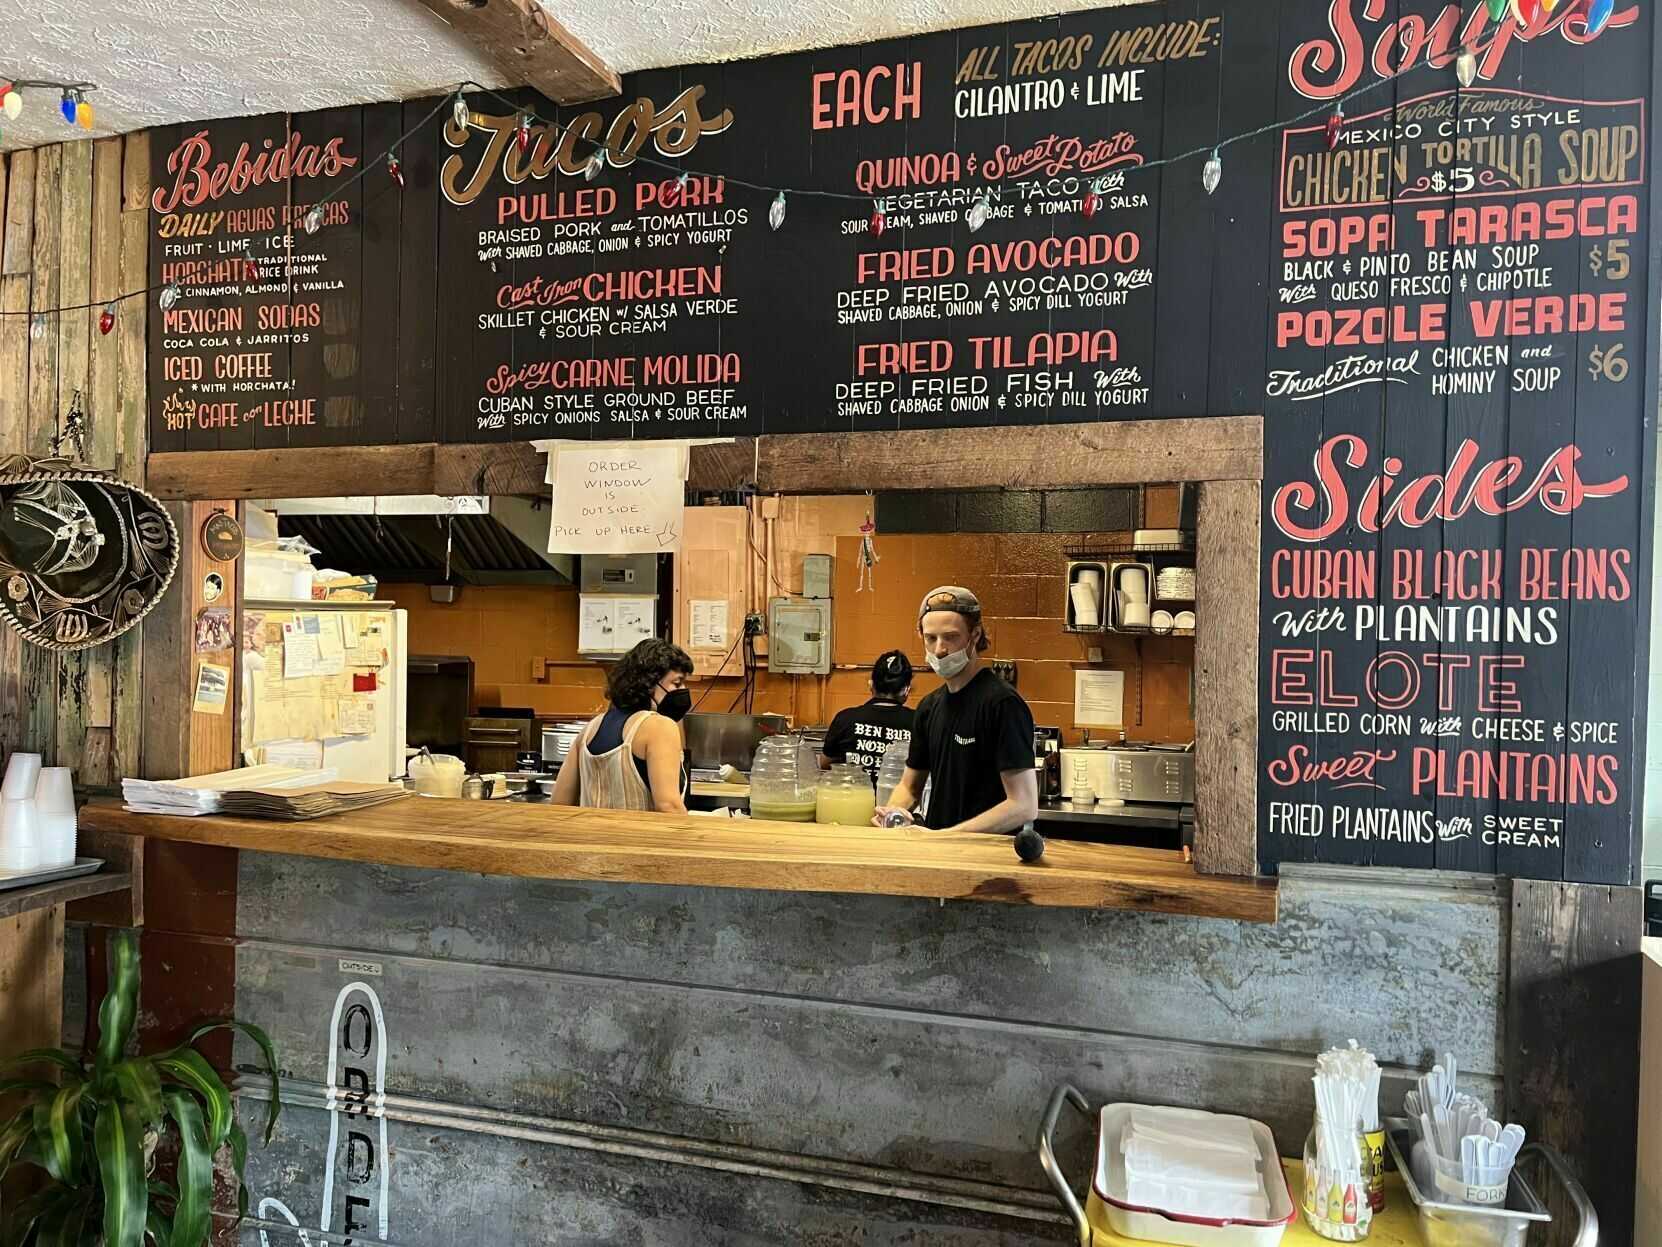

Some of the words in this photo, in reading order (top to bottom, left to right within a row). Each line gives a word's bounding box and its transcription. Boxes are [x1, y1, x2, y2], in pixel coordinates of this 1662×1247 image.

[955, 46, 1001, 85] ALL
[1011, 34, 1093, 76] TACOS
[1098, 17, 1221, 70] INCLUDE:
[1289, 0, 1640, 100] Soups
[812, 62, 922, 130] EACH
[954, 78, 1064, 118] CILANTRO
[1087, 69, 1146, 106] LIME
[1384, 95, 1456, 122] World
[1457, 93, 1545, 113] Famous
[1328, 122, 1422, 145] MEXICO
[1438, 116, 1496, 137] CITY
[1510, 109, 1581, 129] STYLE
[440, 84, 734, 206] Tacos
[152, 130, 358, 213] Bebidas
[856, 152, 961, 194] QUINOA
[983, 132, 1059, 180] Sweet
[1047, 131, 1144, 176] Potato
[1287, 144, 1407, 207] CHICKEN
[1421, 132, 1542, 189] TORTILLA
[1558, 125, 1638, 186] SOUP
[1016, 176, 1080, 200] TACO
[1431, 166, 1475, 193] $5
[498, 187, 616, 225] PULLED
[635, 176, 724, 211] PORK
[841, 220, 868, 235] SOUR
[919, 210, 957, 225] SHAVED
[1110, 194, 1149, 209] SALSA
[158, 210, 224, 238] DAILY
[227, 207, 276, 233] AGUAS
[478, 228, 541, 246] BRAISED
[555, 222, 601, 239] PORK
[611, 220, 635, 233] and
[638, 208, 748, 233] TOMATILLOS
[1283, 214, 1395, 259] SOPA
[1417, 195, 1637, 248] TARASCA
[165, 243, 204, 256] FRUIT
[266, 235, 295, 249] ICE
[258, 254, 328, 264] TRADITIONAL
[478, 248, 502, 262] With
[505, 245, 542, 260] SHAVED
[547, 240, 594, 256] CABBAGE,
[598, 237, 629, 252] ONION
[648, 233, 679, 247] SPICY
[686, 229, 732, 245] YOGURT
[857, 247, 954, 284] FRIED
[967, 231, 1140, 275] AVOCADO
[1589, 239, 1631, 280] $5
[259, 266, 281, 278] RICE
[285, 265, 319, 276] DRINK
[1284, 260, 1334, 282] BLACK
[1360, 253, 1411, 277] PINTO
[1427, 248, 1477, 272] BEAN
[1492, 244, 1539, 268] SOUP
[186, 286, 242, 297] CINNAMON,
[245, 284, 288, 294] ALMOND
[303, 280, 344, 290] VANILLA
[496, 276, 543, 309] Cast
[537, 277, 582, 306] Iron
[583, 265, 722, 301] CHICKEN
[837, 289, 889, 309] DEEP
[903, 282, 969, 304] FRIED
[984, 272, 1109, 298] AVOCADO
[1114, 268, 1153, 288] With
[1279, 285, 1317, 304] With
[1331, 278, 1378, 301] QUESO
[1390, 274, 1451, 298] FRESCO
[1476, 267, 1552, 292] CHIPOTLE
[164, 307, 242, 334] MEXICAN
[258, 303, 320, 330] SODAS
[478, 311, 535, 329] SKILLET
[540, 307, 610, 325] CHICKEN
[634, 303, 677, 320] SALSA
[686, 299, 738, 316] VERDE
[838, 309, 882, 325] SHAVED
[889, 304, 941, 321] CABBAGE,
[945, 301, 983, 317] ONION
[1009, 296, 1041, 312] SPICY
[1046, 294, 1070, 309] DILL
[1078, 291, 1129, 307] YOGURT
[1276, 303, 1447, 348] POZOLE
[1469, 293, 1628, 338] VERDE
[163, 338, 193, 349] COCA
[200, 337, 229, 347] COLA
[248, 333, 309, 345] JARRITOS
[556, 324, 601, 338] SOUR
[609, 320, 667, 335] CREAM
[164, 356, 203, 381] ICED
[215, 353, 273, 379] COFFEE
[858, 340, 952, 376] FRIED
[968, 329, 1117, 370] TILAPIA
[1432, 345, 1509, 369] CHICKEN
[1520, 344, 1552, 359] and
[1588, 343, 1628, 383] $6
[201, 382, 227, 394] WITH
[486, 361, 551, 395] Spicy
[551, 357, 636, 388] CARNE
[643, 353, 741, 385] MOLIDA
[836, 381, 895, 399] DEEP
[912, 375, 988, 397] FRIED
[1007, 371, 1073, 393] FISH
[1094, 366, 1141, 389] With
[1265, 350, 1421, 401] Traditional
[1432, 371, 1497, 396] HOMINY
[1513, 368, 1561, 393] SOUP
[167, 412, 193, 431] HOT
[199, 403, 238, 429] CAFE
[243, 405, 262, 422] con
[263, 399, 316, 427] LECHE
[477, 414, 506, 429] With
[513, 413, 549, 425] SPICY
[555, 411, 600, 424] ONIONS
[610, 409, 649, 422] SALSA
[667, 407, 700, 421] SOUR
[705, 406, 747, 420] CREAM
[479, 396, 534, 413] CUBAN
[543, 394, 595, 410] STYLE
[604, 392, 675, 407] GROUND
[686, 389, 736, 405] BEEF
[837, 400, 882, 416] SHAVED
[890, 398, 943, 414] CABBAGE
[951, 396, 989, 411] ONION
[1015, 392, 1054, 408] SPICY
[1062, 390, 1087, 406] DILL
[1094, 388, 1149, 405] YOGURT
[584, 478, 652, 489] WINDOW
[588, 461, 641, 473] ORDER
[605, 491, 616, 500] IS
[1272, 434, 1629, 543] Sides
[582, 504, 640, 516] OUTSIDE
[555, 526, 581, 537] PICK
[595, 526, 611, 536] UP
[620, 524, 651, 535] HERE
[1272, 549, 1375, 599] CUBAN
[1392, 549, 1501, 600] BLACK
[1520, 548, 1631, 601] BEANS
[1273, 607, 1347, 638] With
[1355, 605, 1558, 645] PLANTAINS
[1272, 649, 1525, 713] ELOTE
[854, 722, 883, 740] BEN
[1272, 711, 1350, 735] GRILLED
[1360, 713, 1412, 736] CORN
[1472, 717, 1545, 742] CHEESE
[1570, 720, 1619, 744] SPICE
[1268, 744, 1397, 792] Sweet
[1412, 747, 1618, 805] PLANTAINS
[1269, 802, 1324, 838] FRIED
[1332, 805, 1434, 844] PLANTAINS
[1435, 815, 1473, 841] With
[1481, 830, 1561, 848] CREAM
[1483, 814, 1563, 832] SWEET
